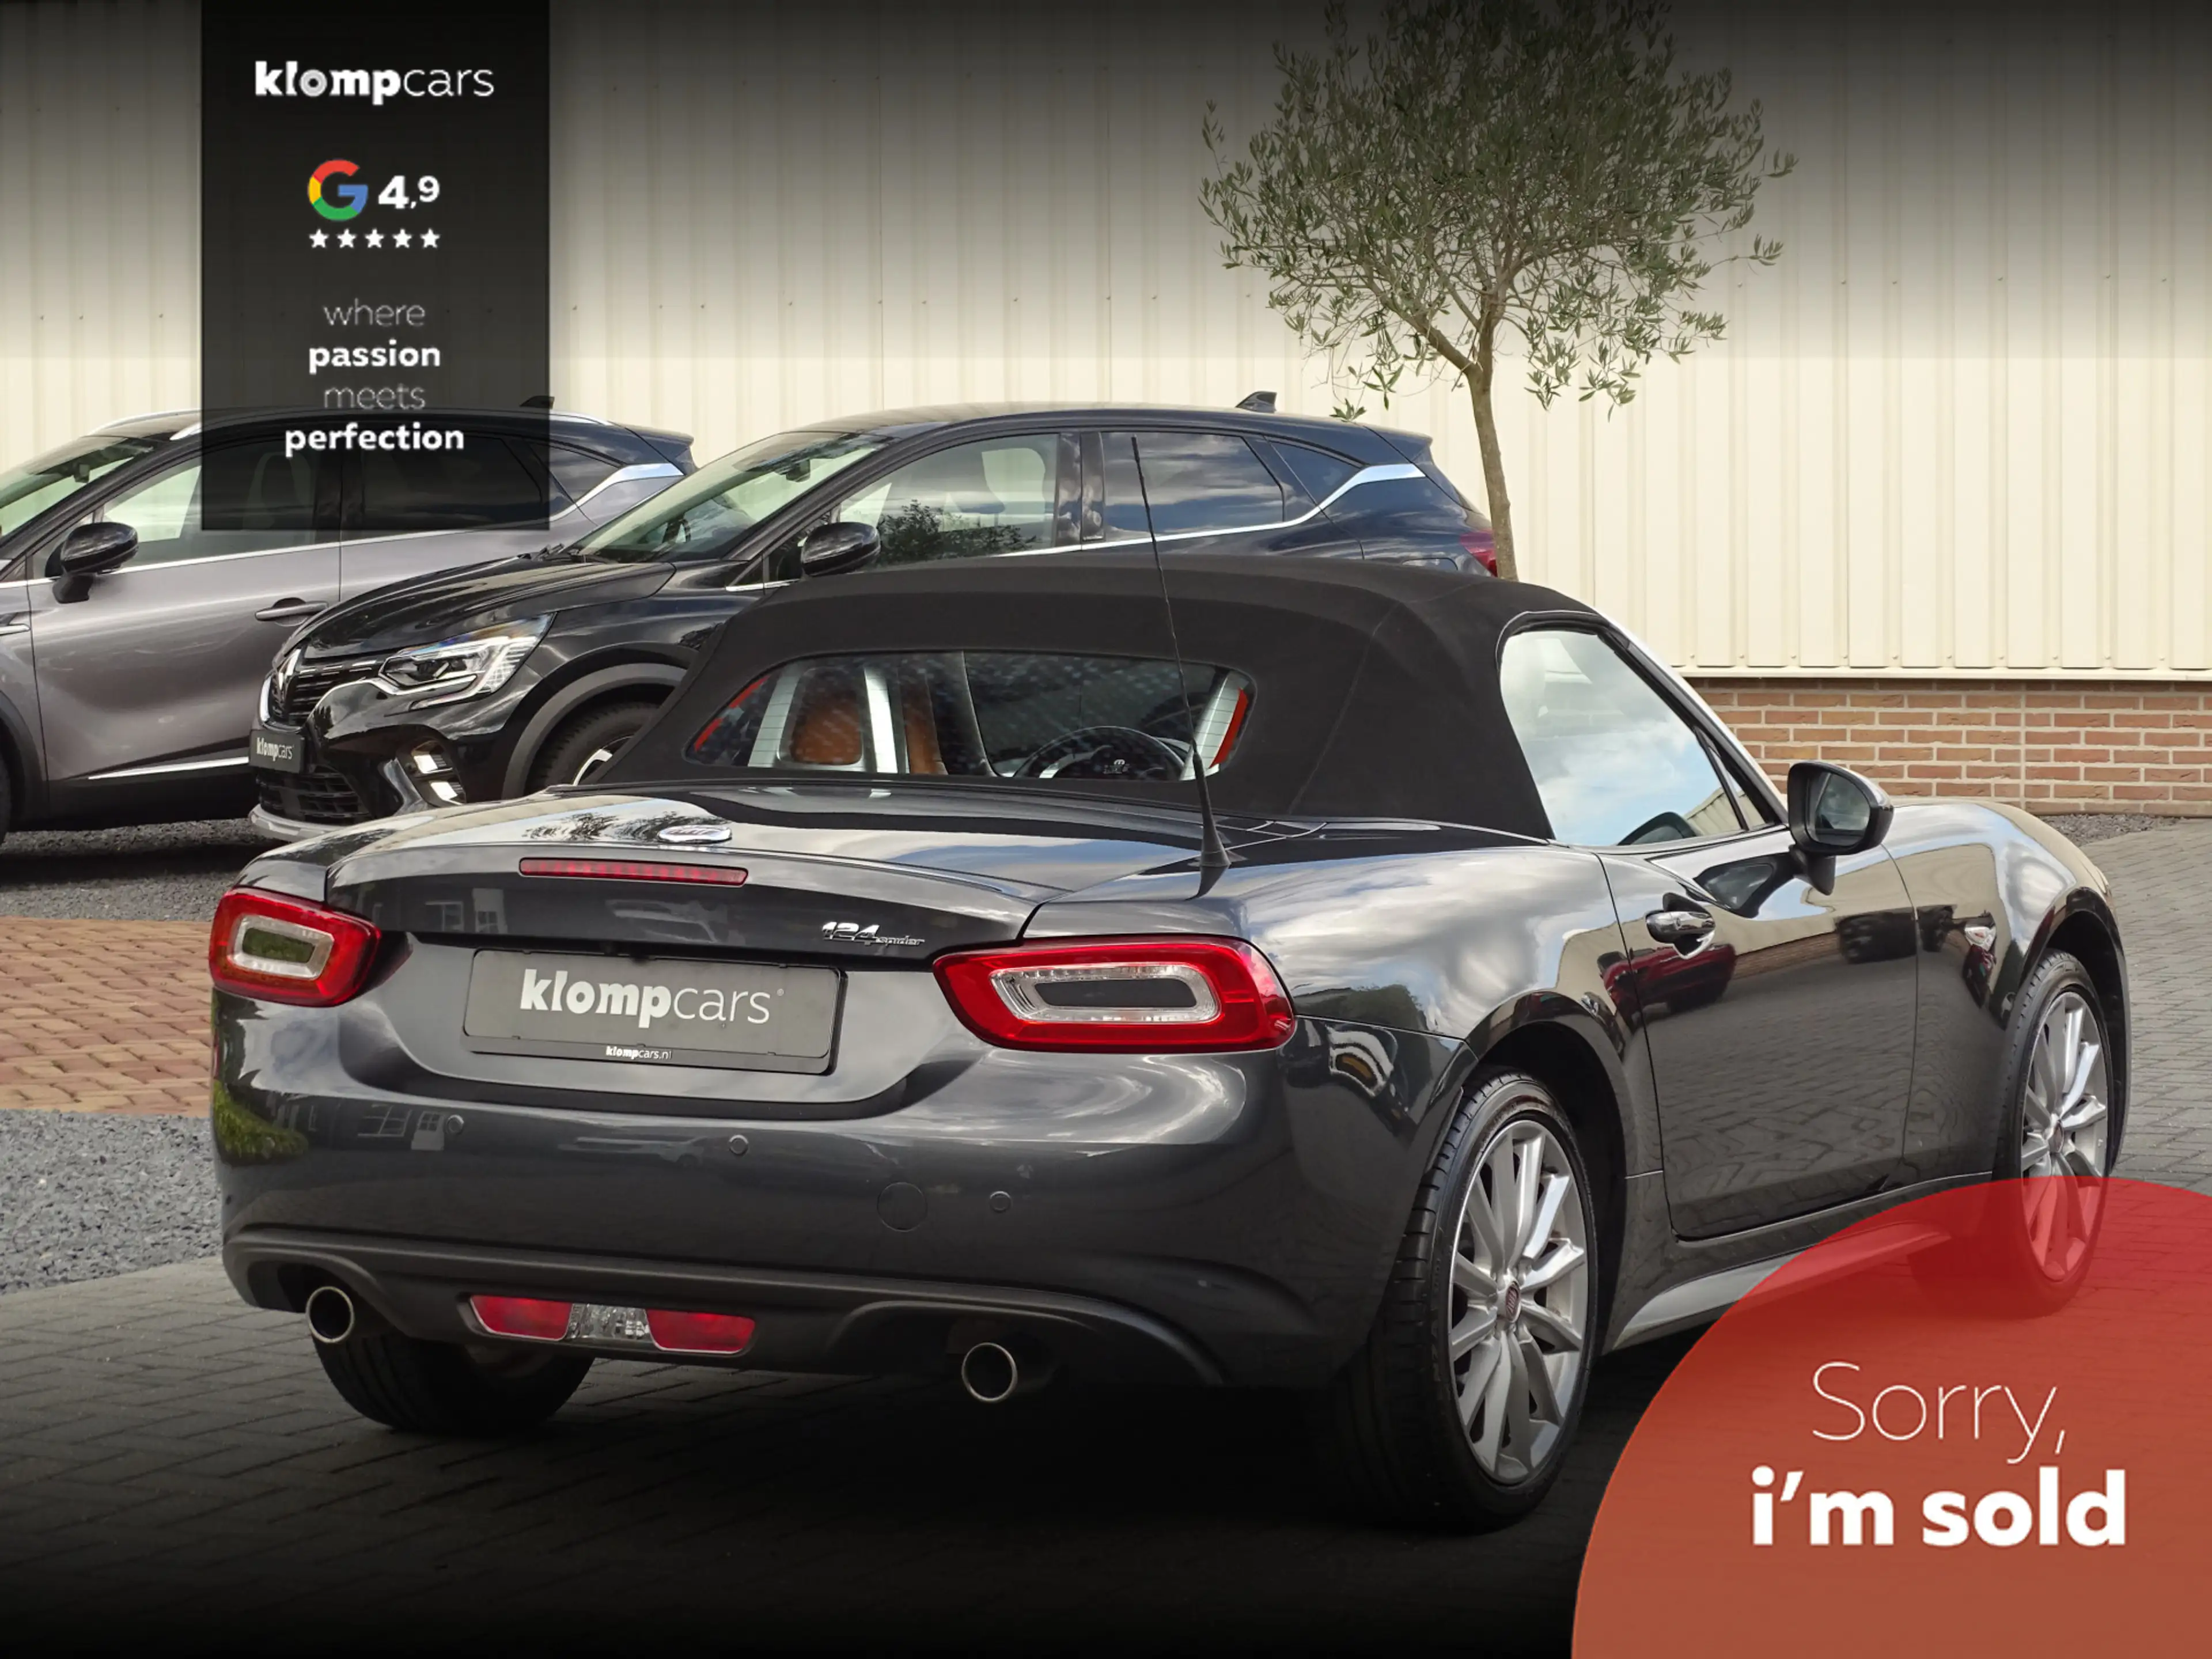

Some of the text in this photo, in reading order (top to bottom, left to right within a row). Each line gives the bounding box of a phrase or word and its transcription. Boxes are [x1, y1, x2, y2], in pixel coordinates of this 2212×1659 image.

[821, 921, 880, 941] 124
[520, 968, 771, 1028] klompcars
[605, 1046, 672, 1060] klompcars.nl
